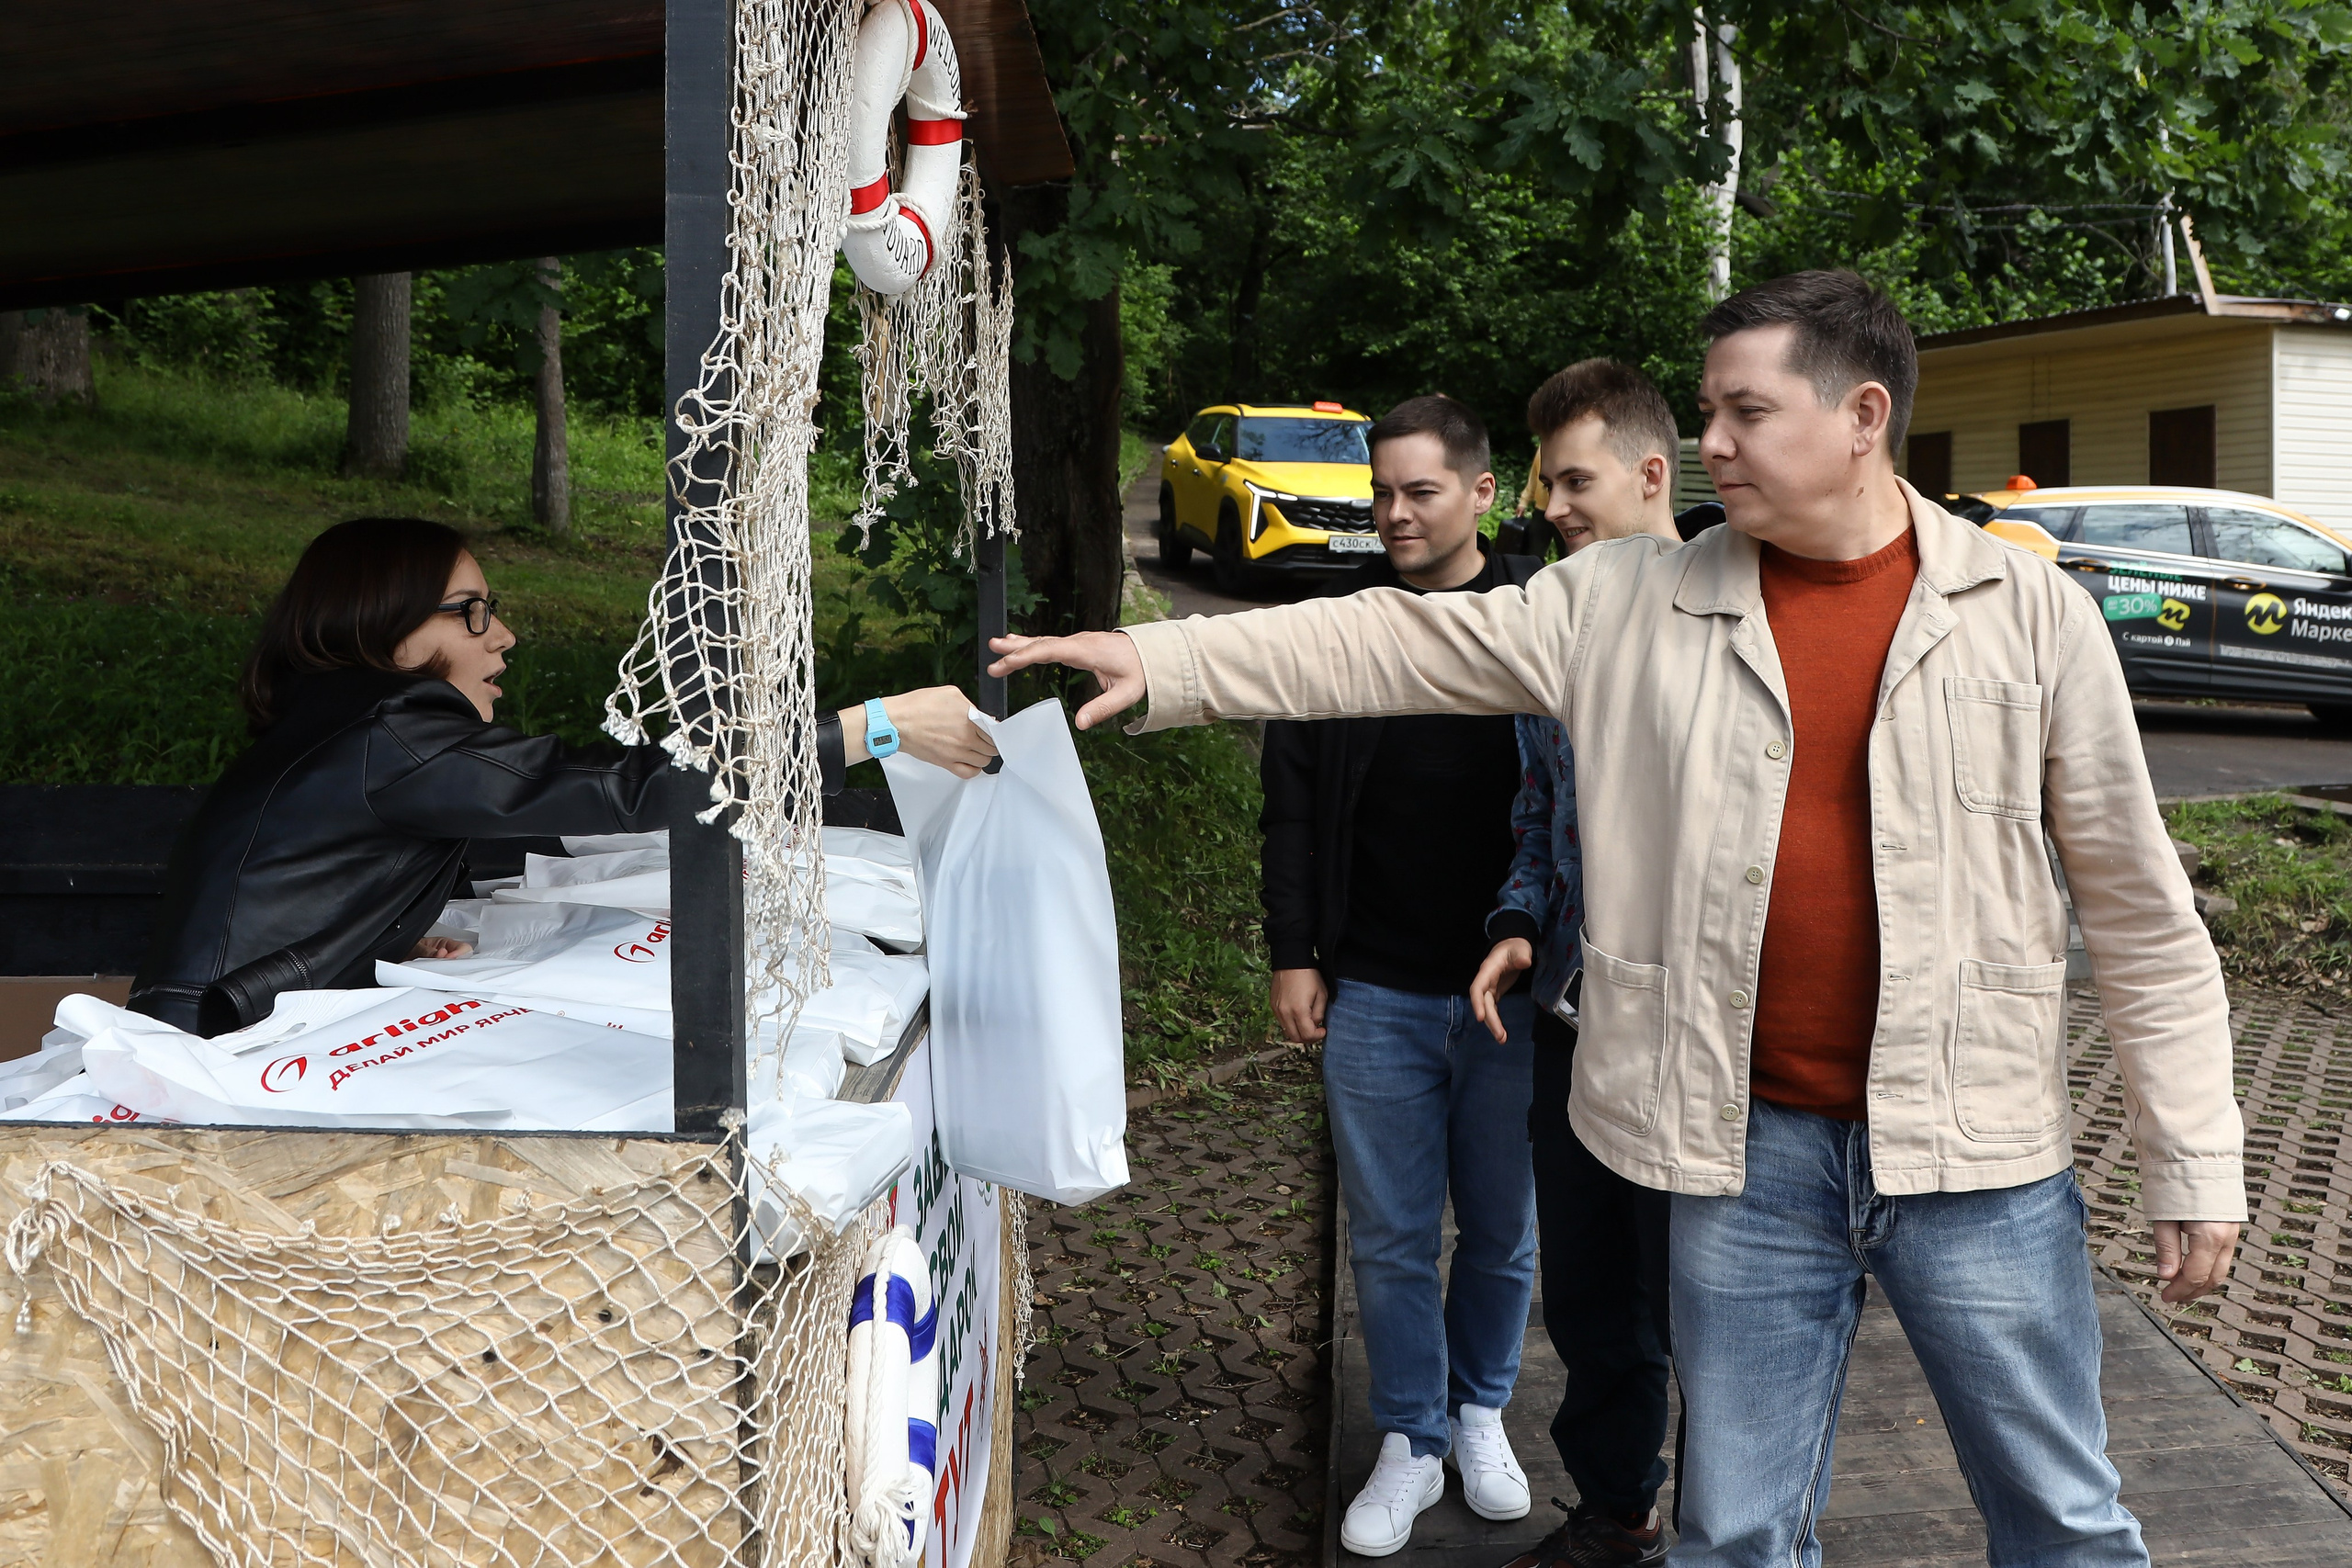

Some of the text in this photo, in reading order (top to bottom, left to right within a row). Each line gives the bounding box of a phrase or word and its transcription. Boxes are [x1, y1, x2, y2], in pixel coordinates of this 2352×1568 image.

[929, 17, 961, 111] WELCOM
[2108, 575, 2207, 601] ЦЕНЫ НИЖЕ
[2119, 596, 2158, 615] 30%
[2293, 597, 2352, 621] Яндек
[2121, 631, 2131, 641] С
[2290, 618, 2352, 643] Марке
[328, 998, 491, 1057] arligh
[329, 1045, 414, 1091] ДЕЛАЙ
[417, 1024, 470, 1049] МИР
[929, 1171, 966, 1326] СВОЙ
[938, 1238, 978, 1439] ДАРОК
[934, 1376, 974, 1568] ТУТ
